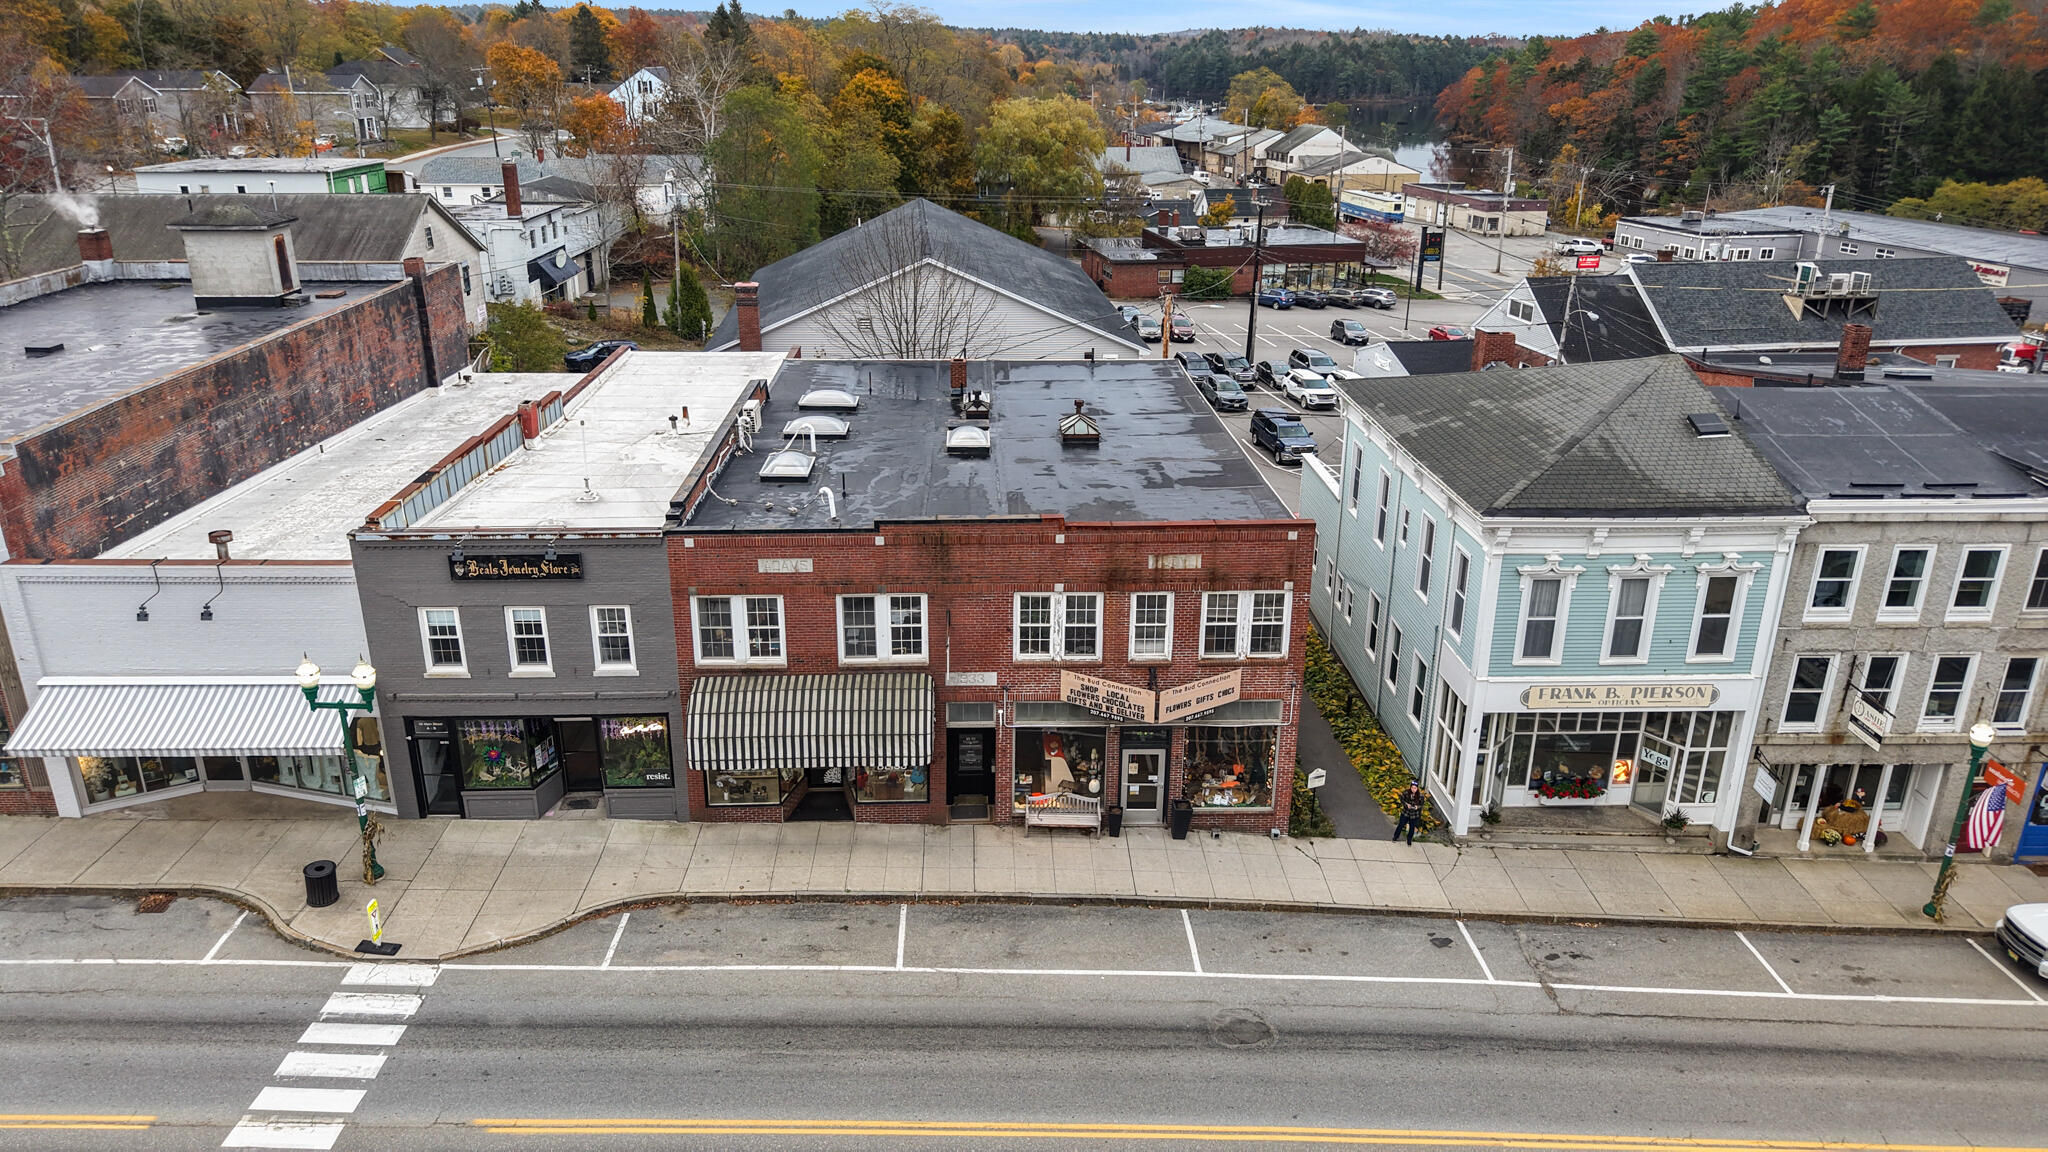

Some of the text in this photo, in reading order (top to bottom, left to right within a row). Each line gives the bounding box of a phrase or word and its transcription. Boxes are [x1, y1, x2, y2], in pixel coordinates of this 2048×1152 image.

[466, 559, 499, 578] Beals
[499, 559, 540, 578] Jewelry
[540, 560, 568, 577] Store
[1074, 674, 1142, 695] The Bud Connection
[1197, 674, 1231, 688] Connection
[1070, 688, 1145, 713] FLOWERS CHOCOLATES
[1081, 684, 1130, 702] SHOP LOCAL
[1165, 686, 1235, 714] FLOWERS GIFTS CHOCS
[1538, 686, 1708, 700] FRANK B. PIERSON
[1066, 695, 1145, 720] GIFTS AND WE DELIVER
[1643, 747, 1669, 766] Yoga
[646, 772, 671, 780] resist.
